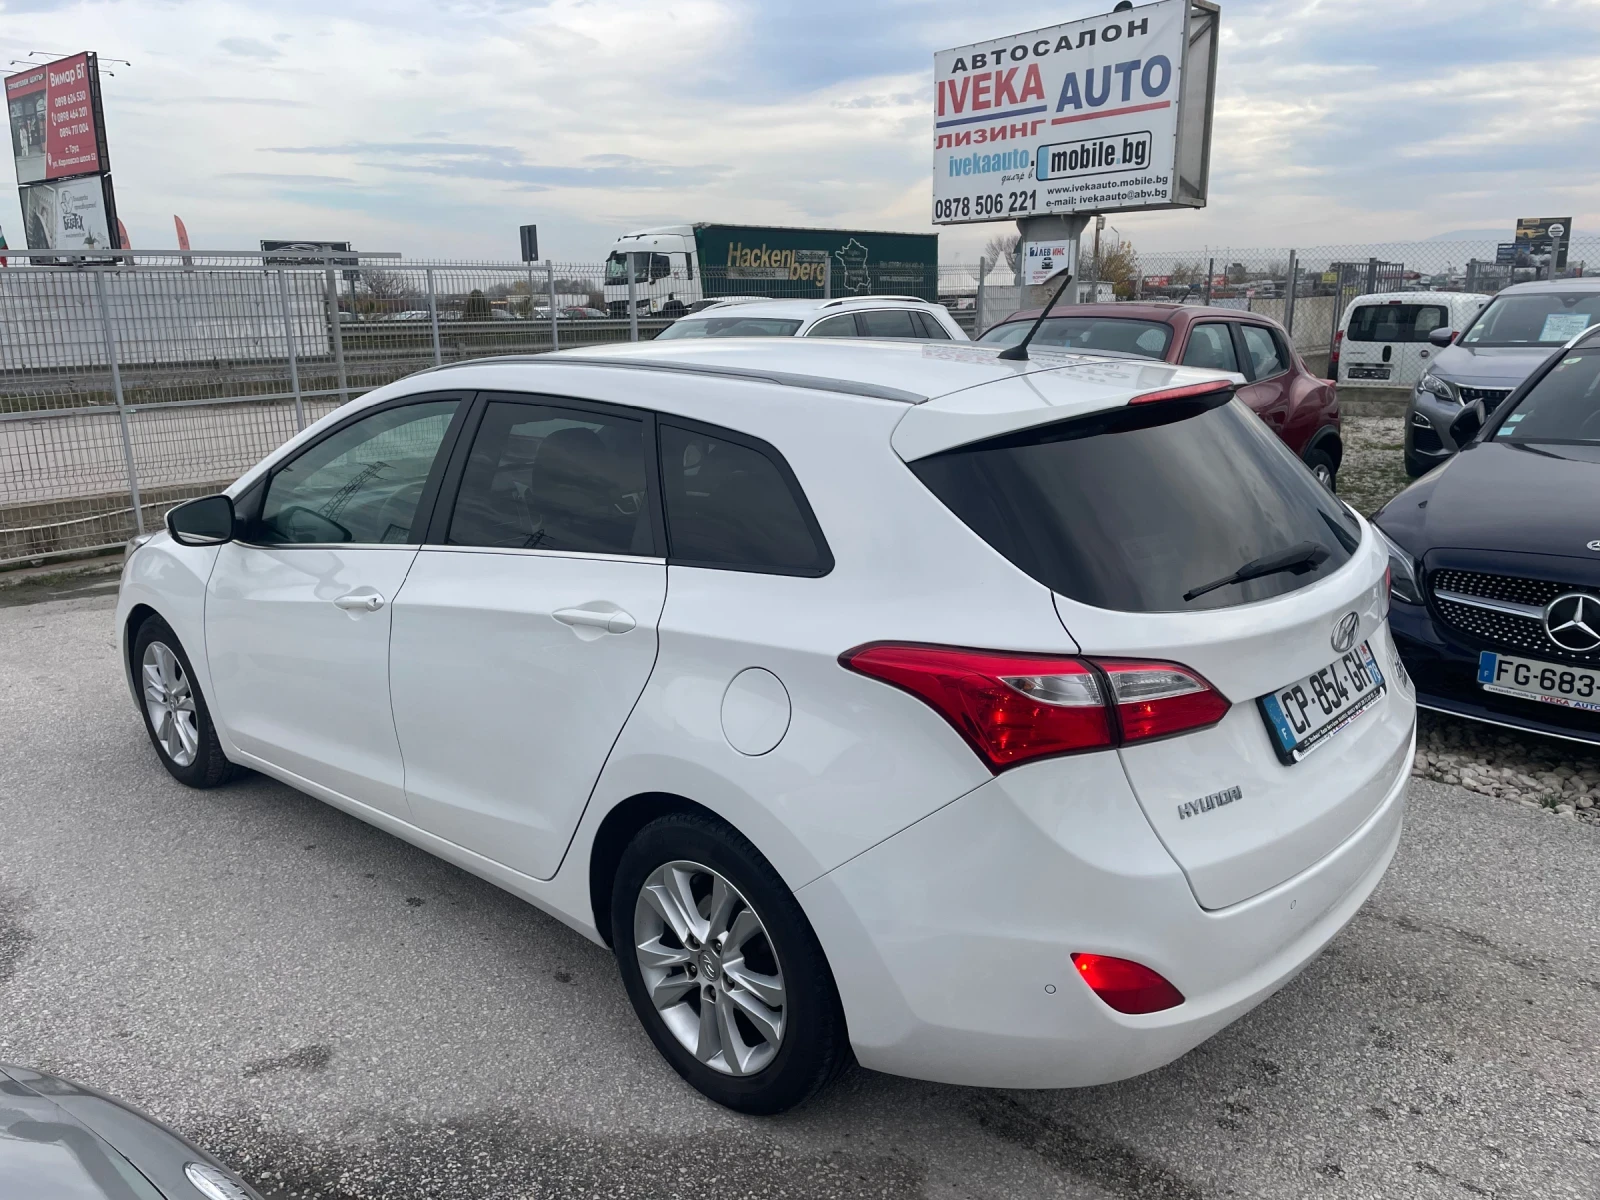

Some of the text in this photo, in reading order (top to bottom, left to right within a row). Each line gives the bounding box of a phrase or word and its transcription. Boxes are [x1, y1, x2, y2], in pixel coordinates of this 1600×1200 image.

[951, 17, 1149, 74] АВТОСАЛОН
[50, 62, 85, 87] Вимар БГ
[937, 54, 1172, 117] IVEKA AUTO
[936, 119, 1047, 150] ЛИЗИНГ
[1051, 138, 1148, 173] mobile.bg
[1047, 175, 1169, 195] www.ivekaauto.mobile.bg
[935, 190, 1038, 219] 0878 506 221
[1046, 188, 1168, 208] e-mail: ivekaauto@abv.bg
[1039, 247, 1066, 257] ЛЕВ ИНС
[1484, 670, 1490, 678] F
[1541, 695, 1570, 706] IVEKA
[1281, 727, 1288, 740] F
[1178, 784, 1243, 820] HYUNDAI
